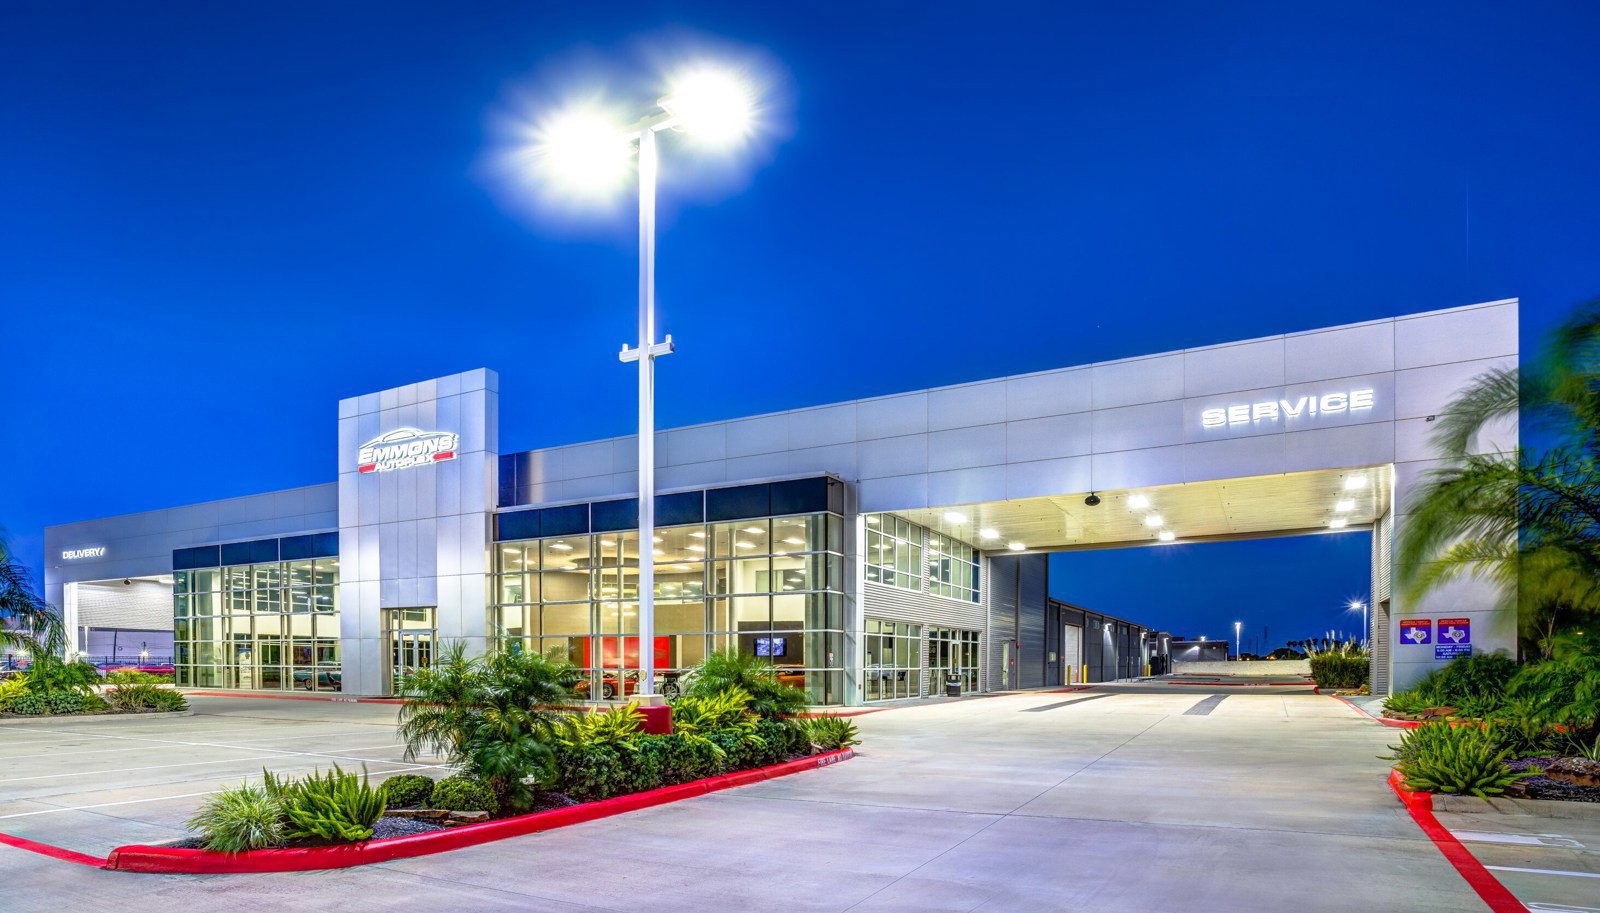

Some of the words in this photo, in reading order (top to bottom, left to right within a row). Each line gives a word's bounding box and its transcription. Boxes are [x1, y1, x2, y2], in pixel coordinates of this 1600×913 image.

[1201, 389, 1374, 427] SERVICE
[358, 435, 456, 464] EMMONS
[374, 454, 433, 472] AUTOPLEX
